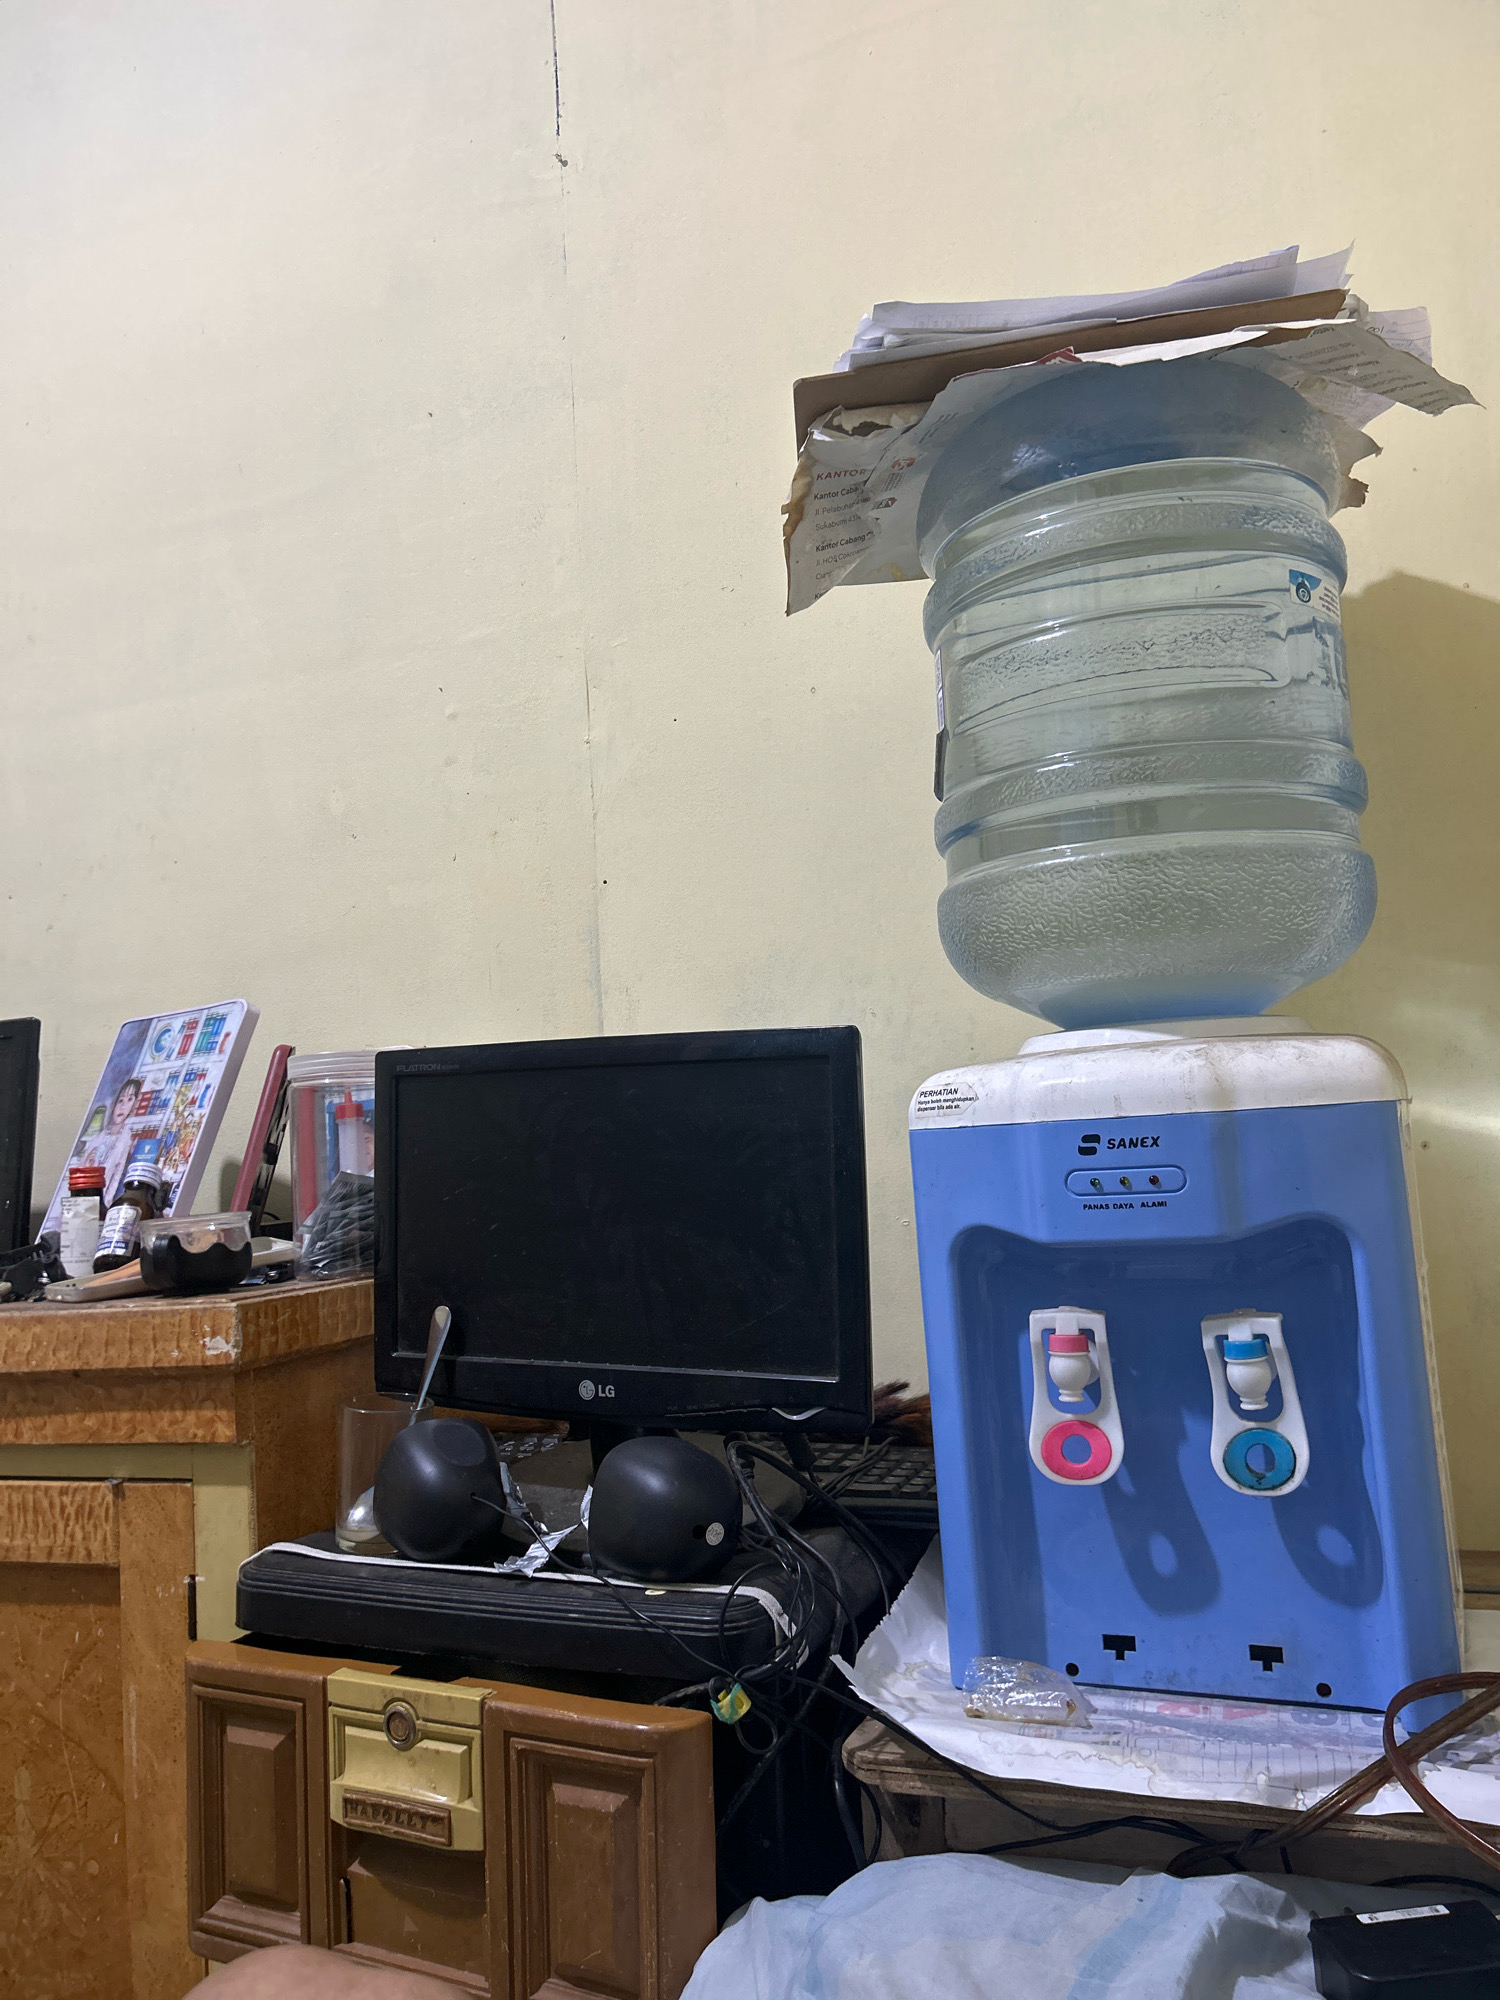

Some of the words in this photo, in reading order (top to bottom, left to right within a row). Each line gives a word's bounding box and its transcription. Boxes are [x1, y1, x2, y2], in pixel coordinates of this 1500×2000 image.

[816, 469, 866, 481] KANTOR
[813, 490, 840, 501] Kantor
[815, 541, 839, 553] Kantor
[839, 534, 866, 547] Cabang
[396, 1063, 441, 1073] FLATRON
[920, 1088, 959, 1098] PERHATIAN
[1106, 1135, 1161, 1150] SANEX
[1082, 1202, 1110, 1211] PANAS
[1112, 1202, 1135, 1210] DAYA
[1140, 1200, 1168, 1208] ALAMI
[598, 1384, 616, 1398] LG
